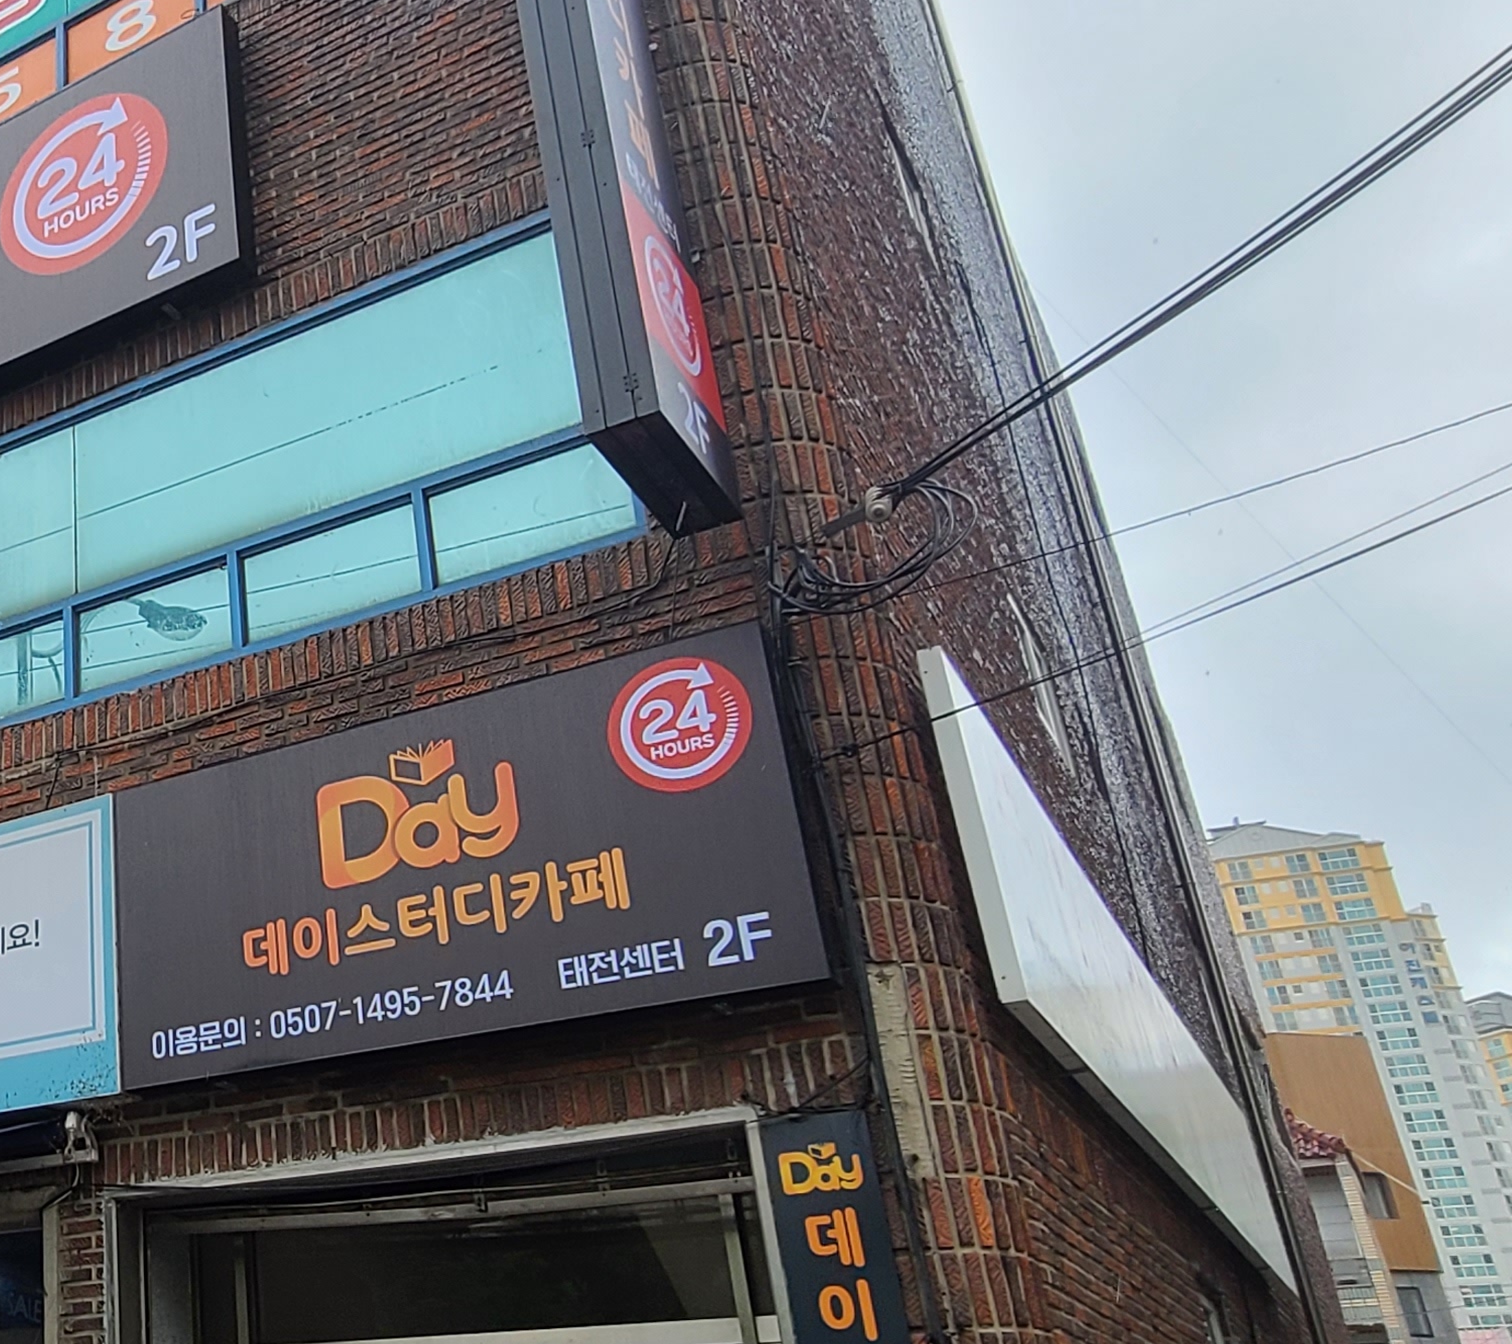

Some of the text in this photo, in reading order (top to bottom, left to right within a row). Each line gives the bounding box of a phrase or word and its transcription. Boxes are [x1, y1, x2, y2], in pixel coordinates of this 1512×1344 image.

[37, 130, 125, 219] 24
[44, 186, 120, 238] HOURS
[145, 203, 217, 280] 2F
[677, 381, 710, 455] 2F
[638, 690, 717, 746] 24
[649, 732, 716, 761] HOURS
[316, 761, 521, 890] Day
[243, 848, 631, 976] 데이스터디카페
[152, 1016, 247, 1059] 이용문의
[269, 970, 514, 1040] 0507-1495-7844
[558, 938, 686, 990] 태전센터
[702, 911, 773, 968] 2F
[778, 1152, 864, 1196] Day
